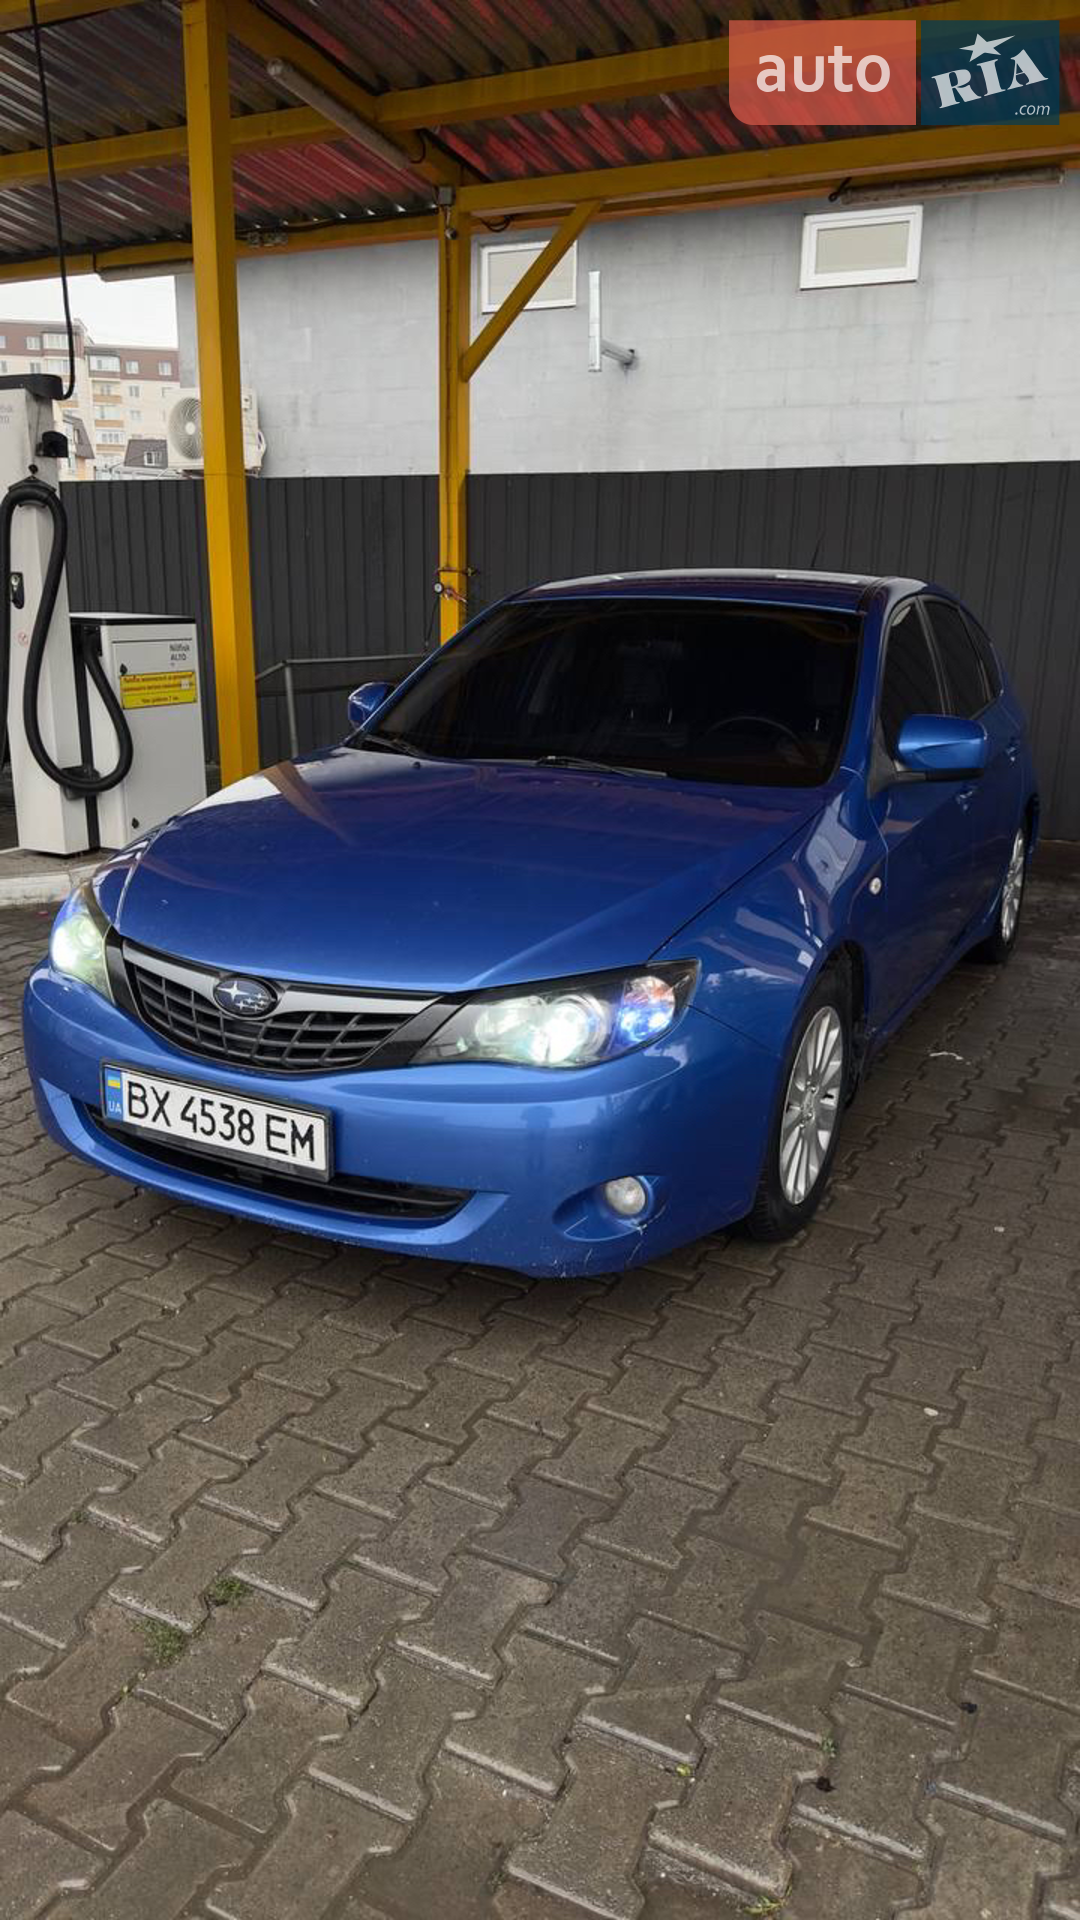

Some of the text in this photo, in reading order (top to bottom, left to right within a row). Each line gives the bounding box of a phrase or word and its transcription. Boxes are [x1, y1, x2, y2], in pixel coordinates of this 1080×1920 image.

[170, 652, 187, 661] ALTO
[108, 1100, 122, 1114] UA
[127, 1081, 316, 1162] BX 4538 EM
